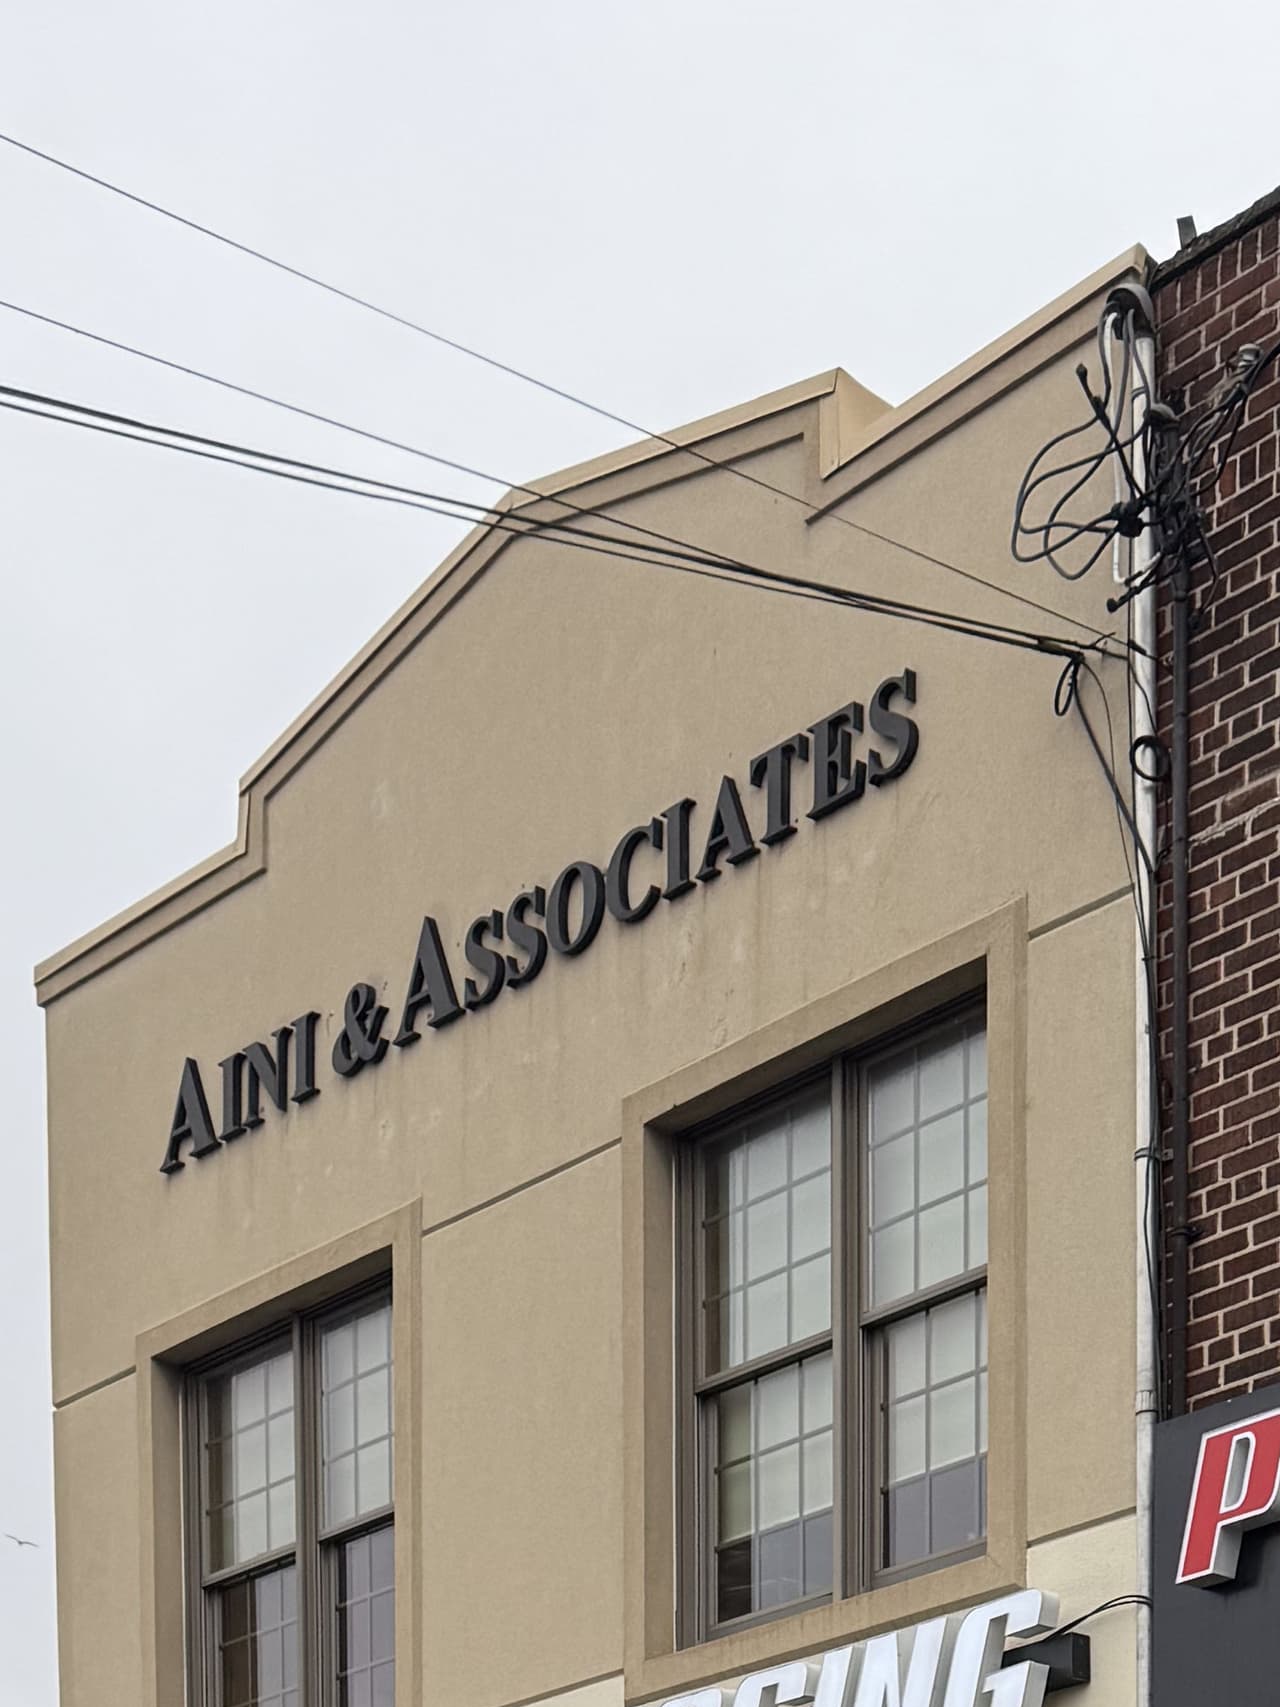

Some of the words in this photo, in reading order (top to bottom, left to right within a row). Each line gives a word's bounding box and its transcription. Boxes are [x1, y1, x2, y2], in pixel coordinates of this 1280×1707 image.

[160, 1011, 321, 1175] AINI
[330, 983, 390, 1079] &
[393, 669, 919, 1047] ASSOCIATES
